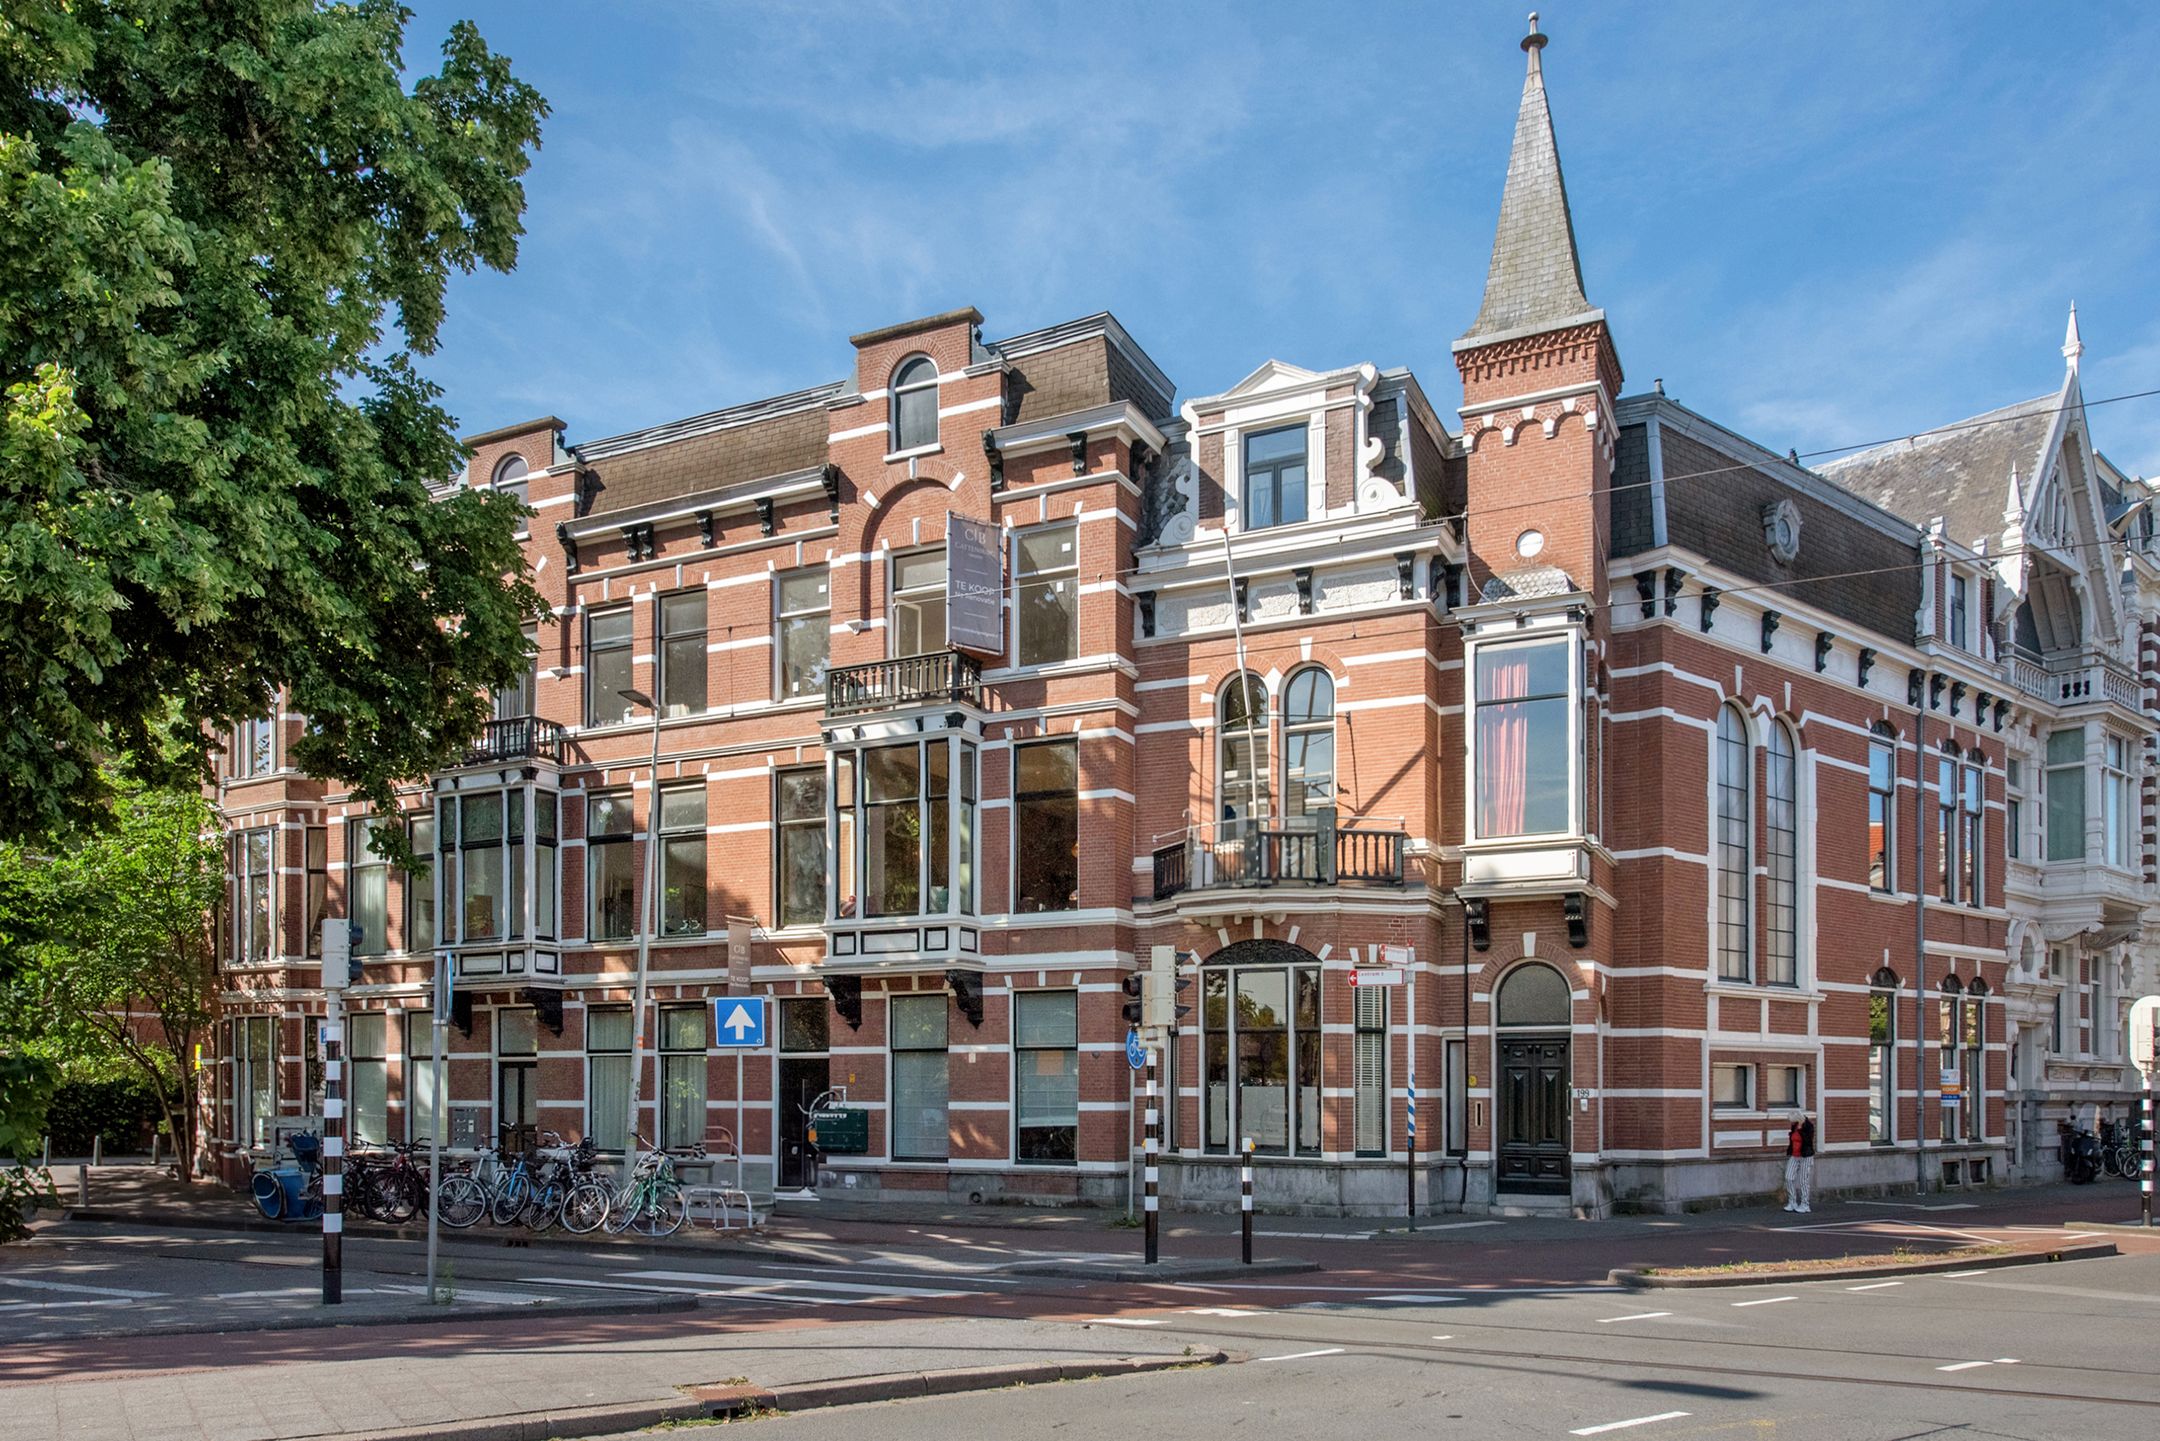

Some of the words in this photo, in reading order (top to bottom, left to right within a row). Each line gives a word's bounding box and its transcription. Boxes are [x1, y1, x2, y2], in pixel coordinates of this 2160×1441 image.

[955, 580, 967, 591] TE
[968, 583, 995, 596] KOOP
[1577, 1088, 1589, 1098] 199
